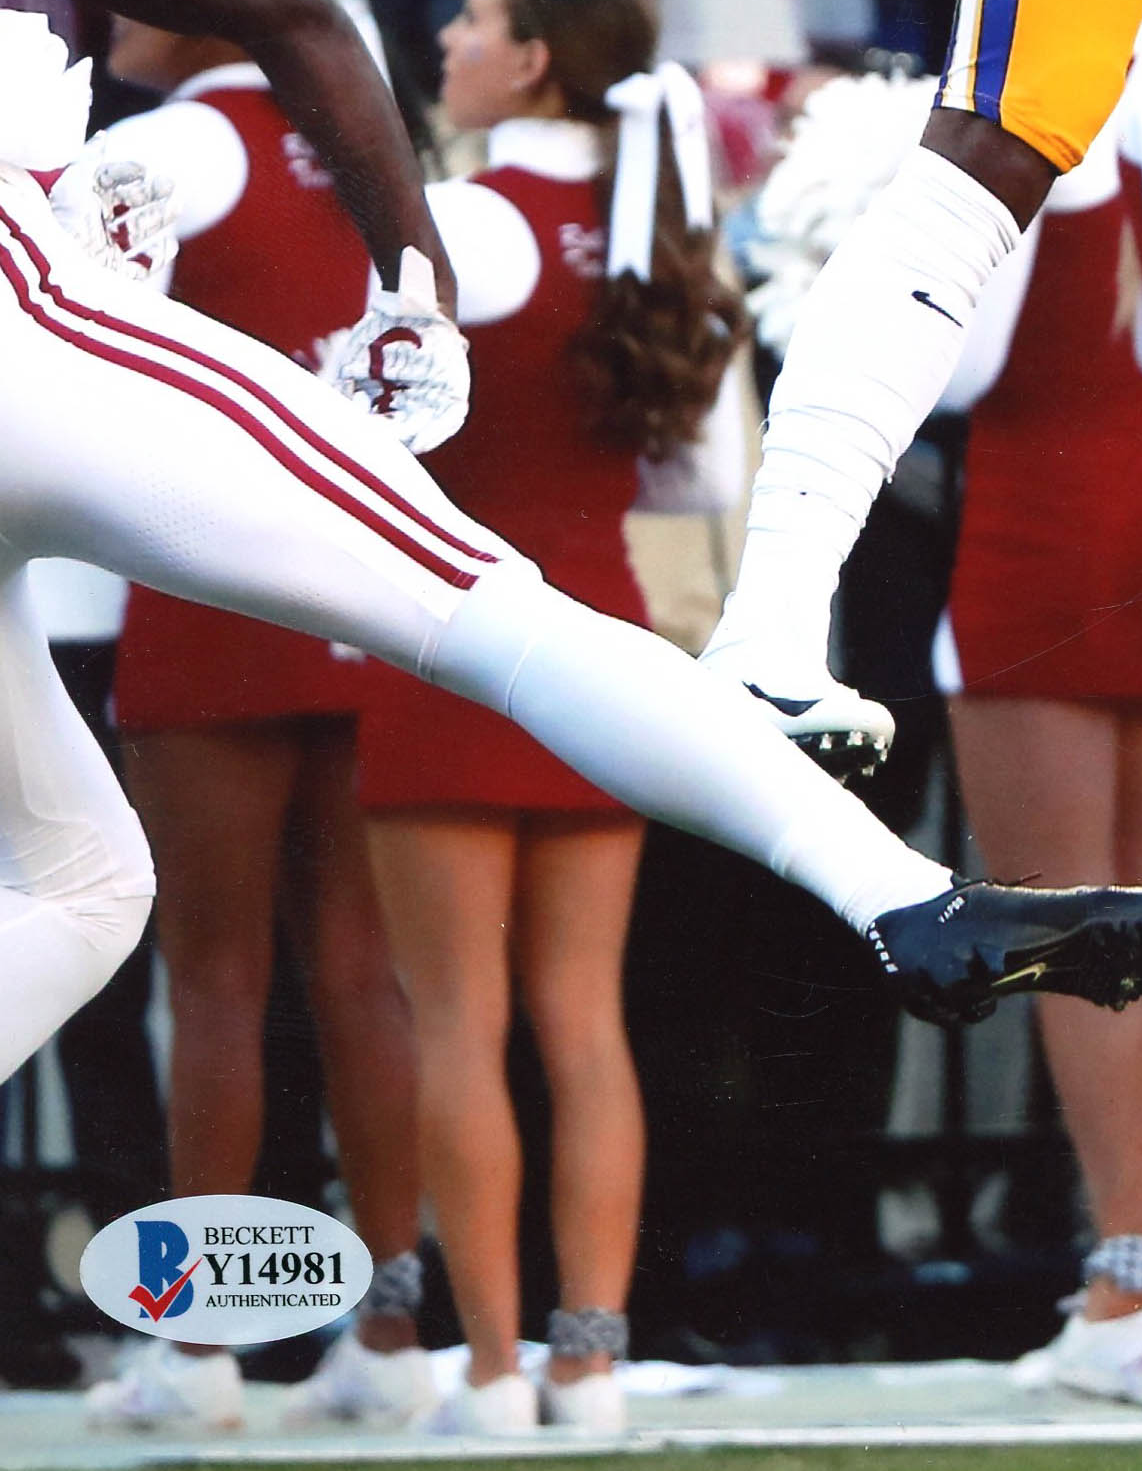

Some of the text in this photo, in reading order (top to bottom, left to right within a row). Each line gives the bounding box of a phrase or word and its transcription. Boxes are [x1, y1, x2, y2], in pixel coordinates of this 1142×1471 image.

[204, 1226, 315, 1245] BECKETT
[203, 1252, 346, 1285] Y14981
[205, 1293, 342, 1307] AUTHENTICATED
